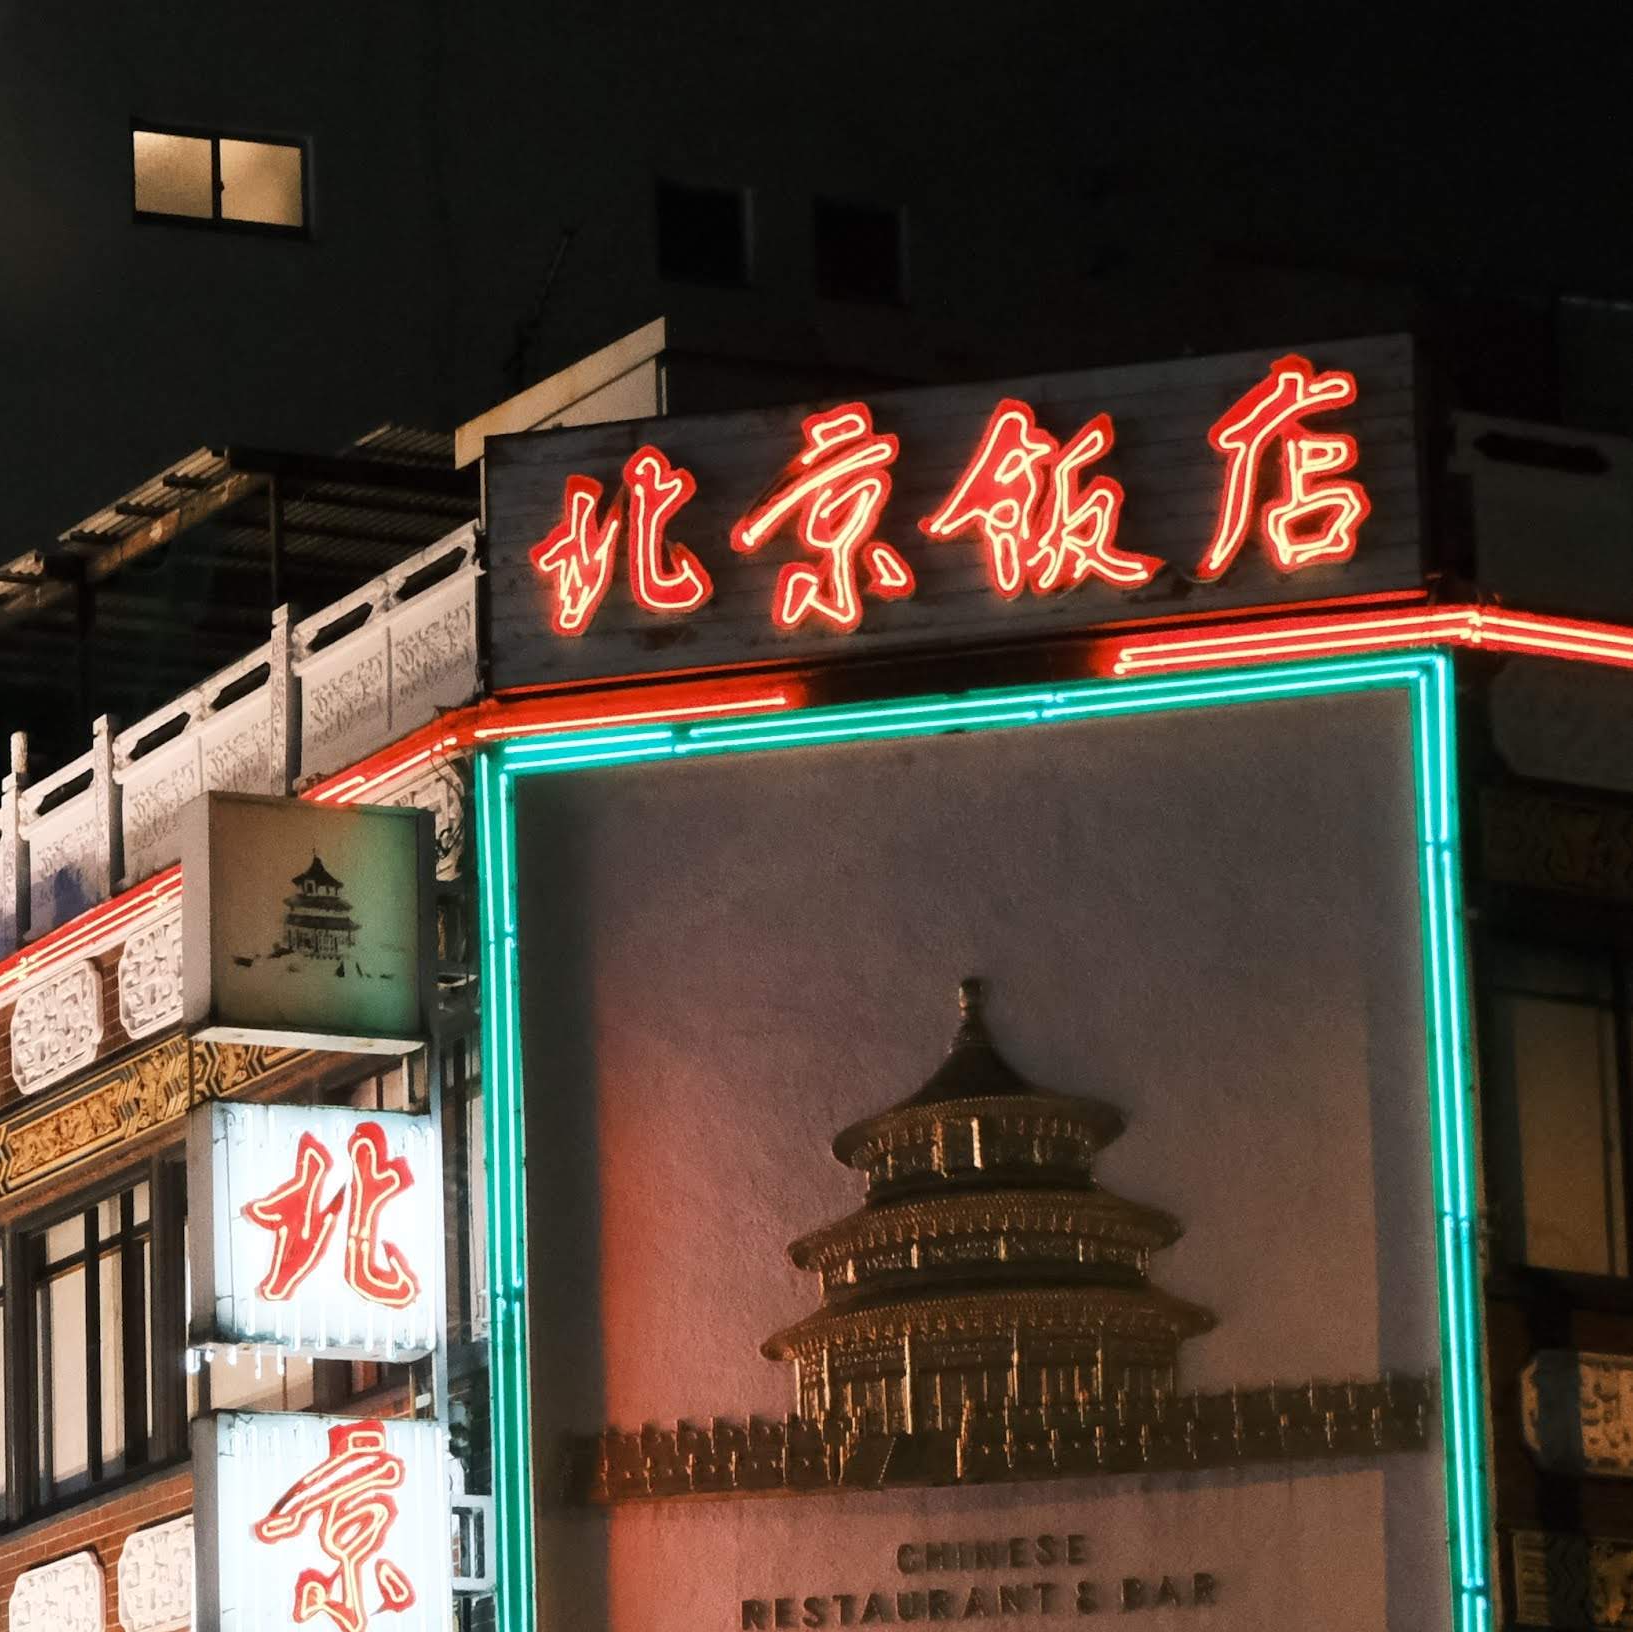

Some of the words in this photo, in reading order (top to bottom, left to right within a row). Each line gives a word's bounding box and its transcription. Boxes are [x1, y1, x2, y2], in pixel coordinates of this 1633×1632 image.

[529, 352, 1372, 637] 北京飯店
[896, 1534, 1089, 1575] CHINESE
[741, 1582, 1054, 1631] RESTAURANT
[1123, 1572, 1220, 1611] BAR
